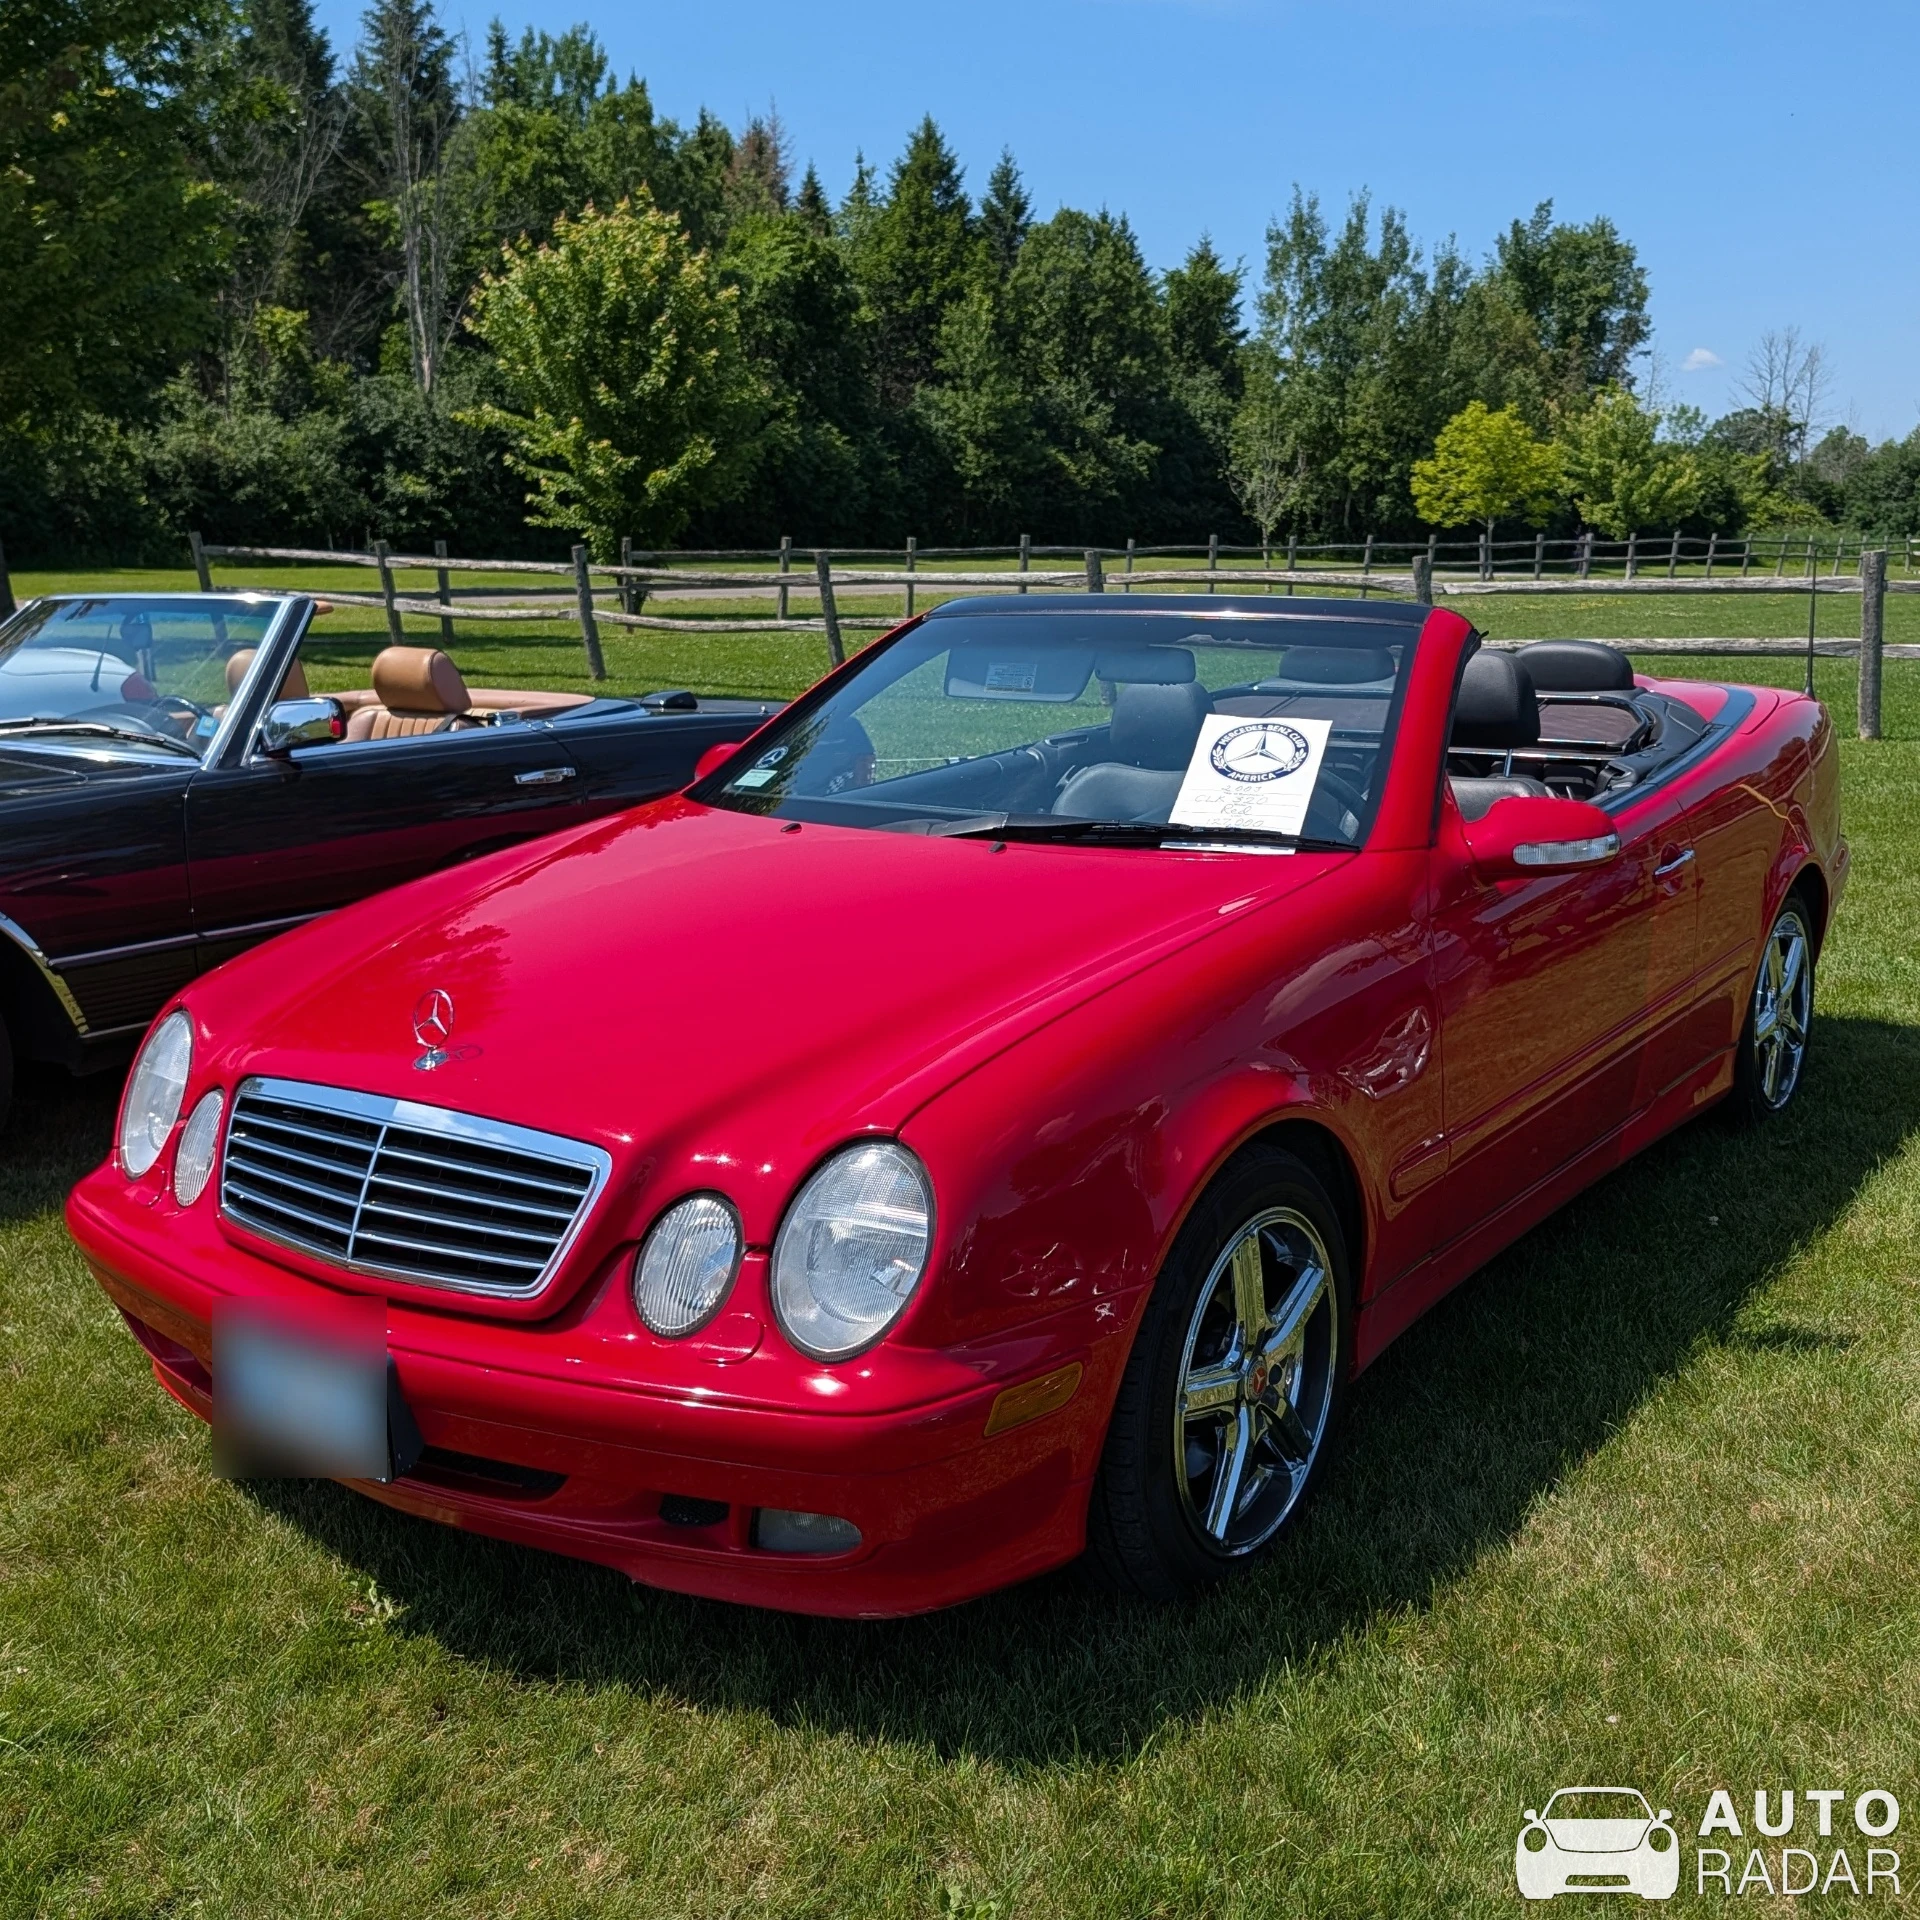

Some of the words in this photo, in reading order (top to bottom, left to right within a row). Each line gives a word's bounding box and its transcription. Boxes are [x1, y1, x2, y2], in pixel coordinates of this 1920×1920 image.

[1287, 732, 1307, 748] CLUB
[1227, 771, 1277, 782] AMERICA
[1194, 794, 1225, 803] CLK
[1232, 796, 1269, 806] 320
[1220, 804, 1253, 816] Red
